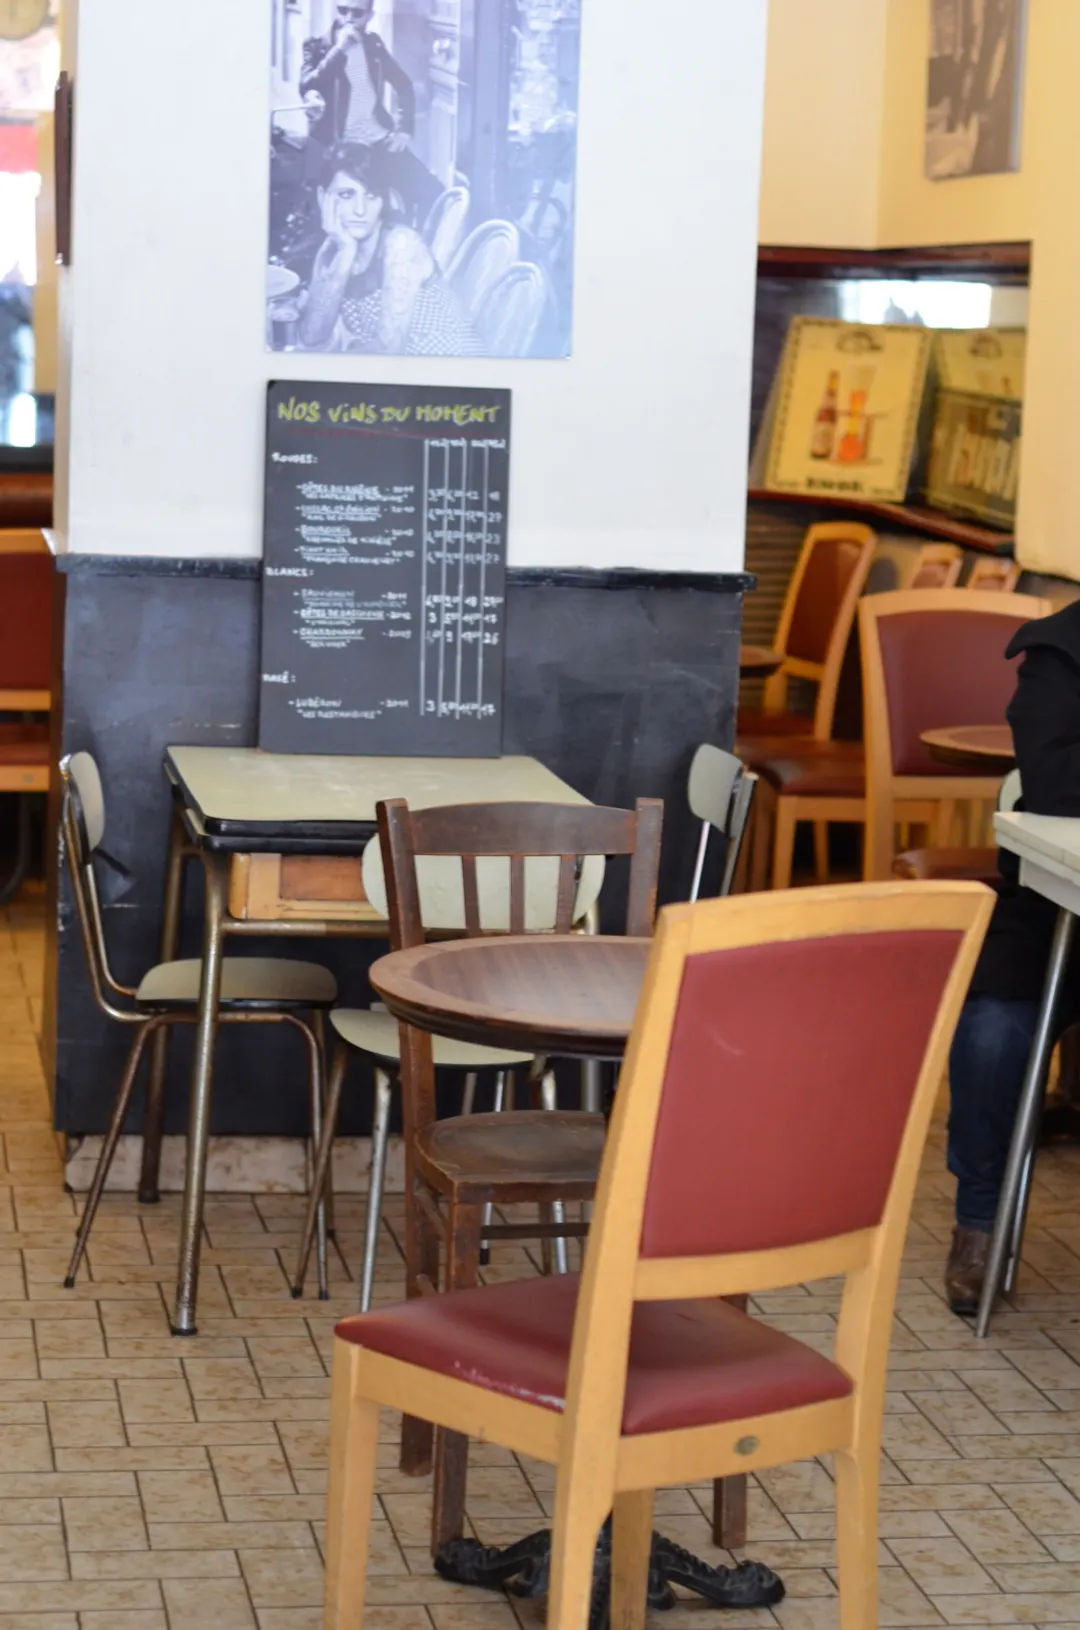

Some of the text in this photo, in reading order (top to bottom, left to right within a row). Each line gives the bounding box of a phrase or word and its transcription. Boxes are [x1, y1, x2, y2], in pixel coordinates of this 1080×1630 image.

[277, 396, 321, 423] NOS
[380, 405, 411, 423] DU
[415, 403, 502, 426] MOMENT
